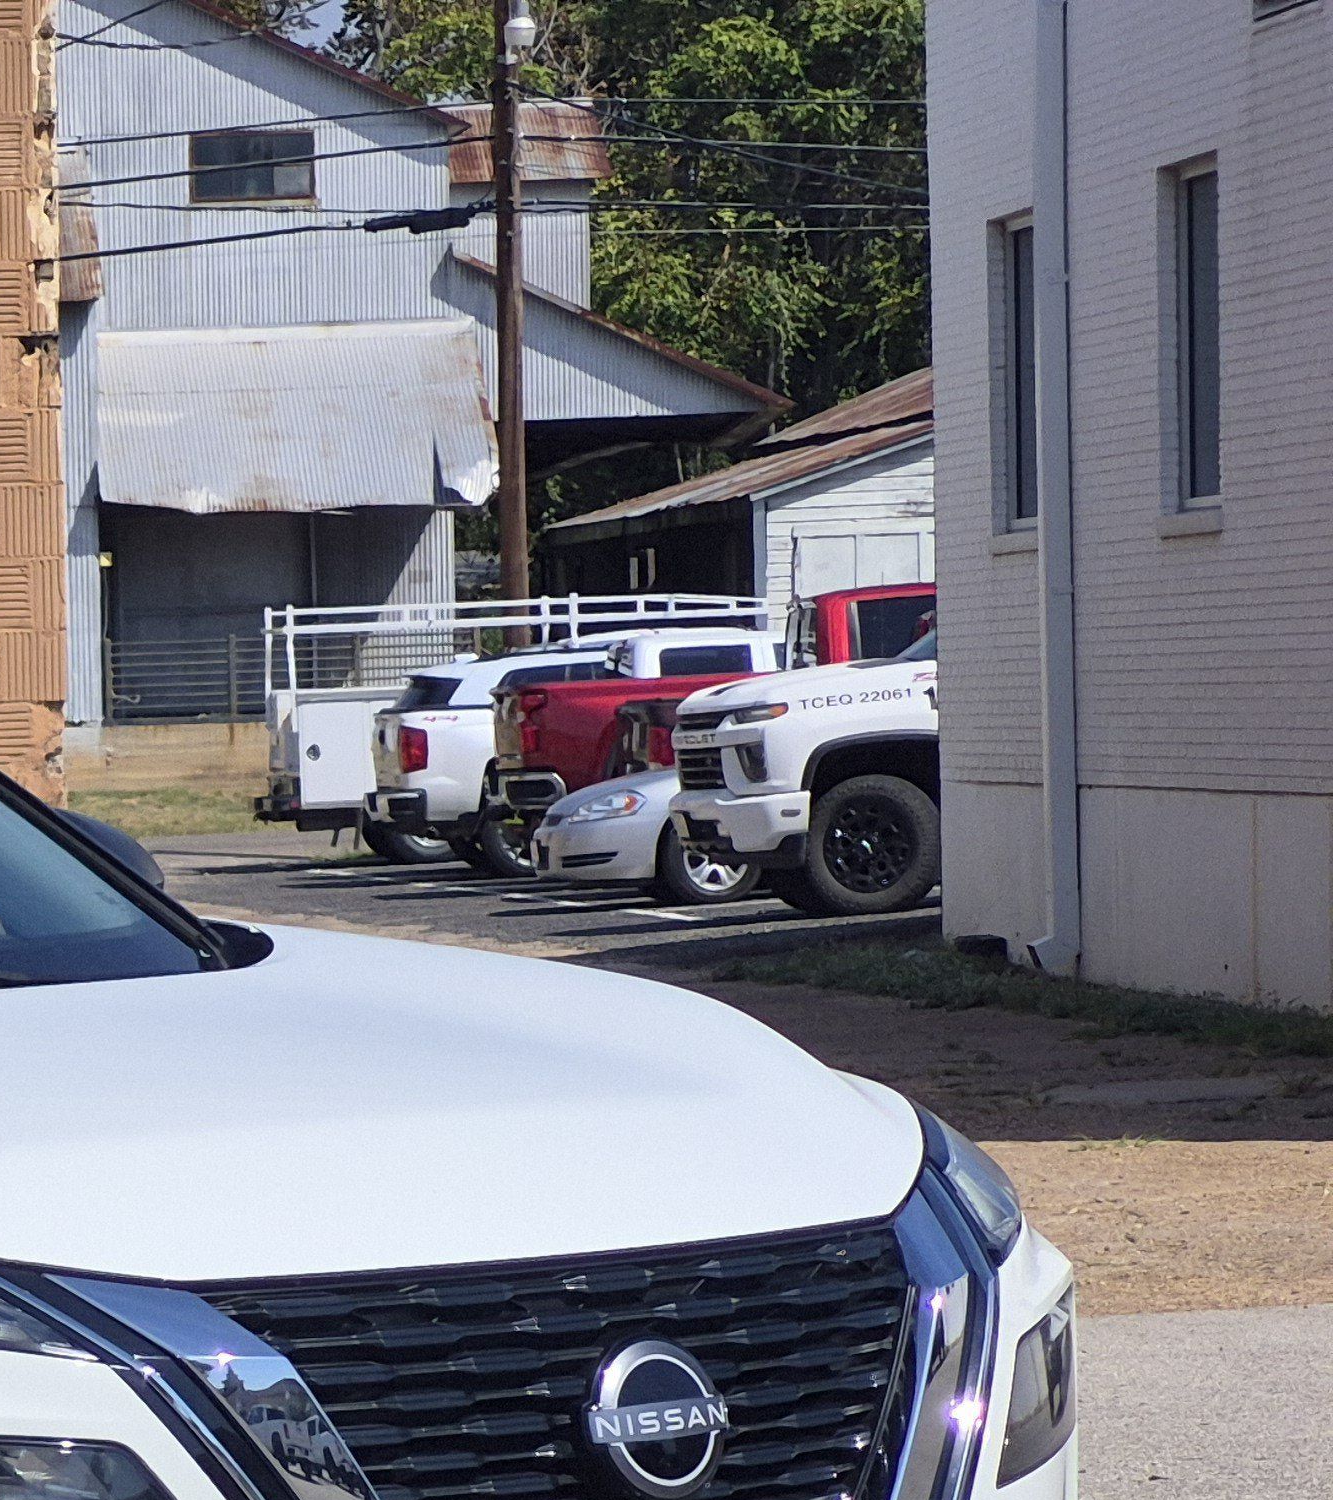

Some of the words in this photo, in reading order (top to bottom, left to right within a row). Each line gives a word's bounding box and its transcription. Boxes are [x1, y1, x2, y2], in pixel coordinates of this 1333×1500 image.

[799, 694, 853, 710] TCEQ
[859, 688, 912, 703] 22061
[594, 1401, 727, 1439] NISSAN
